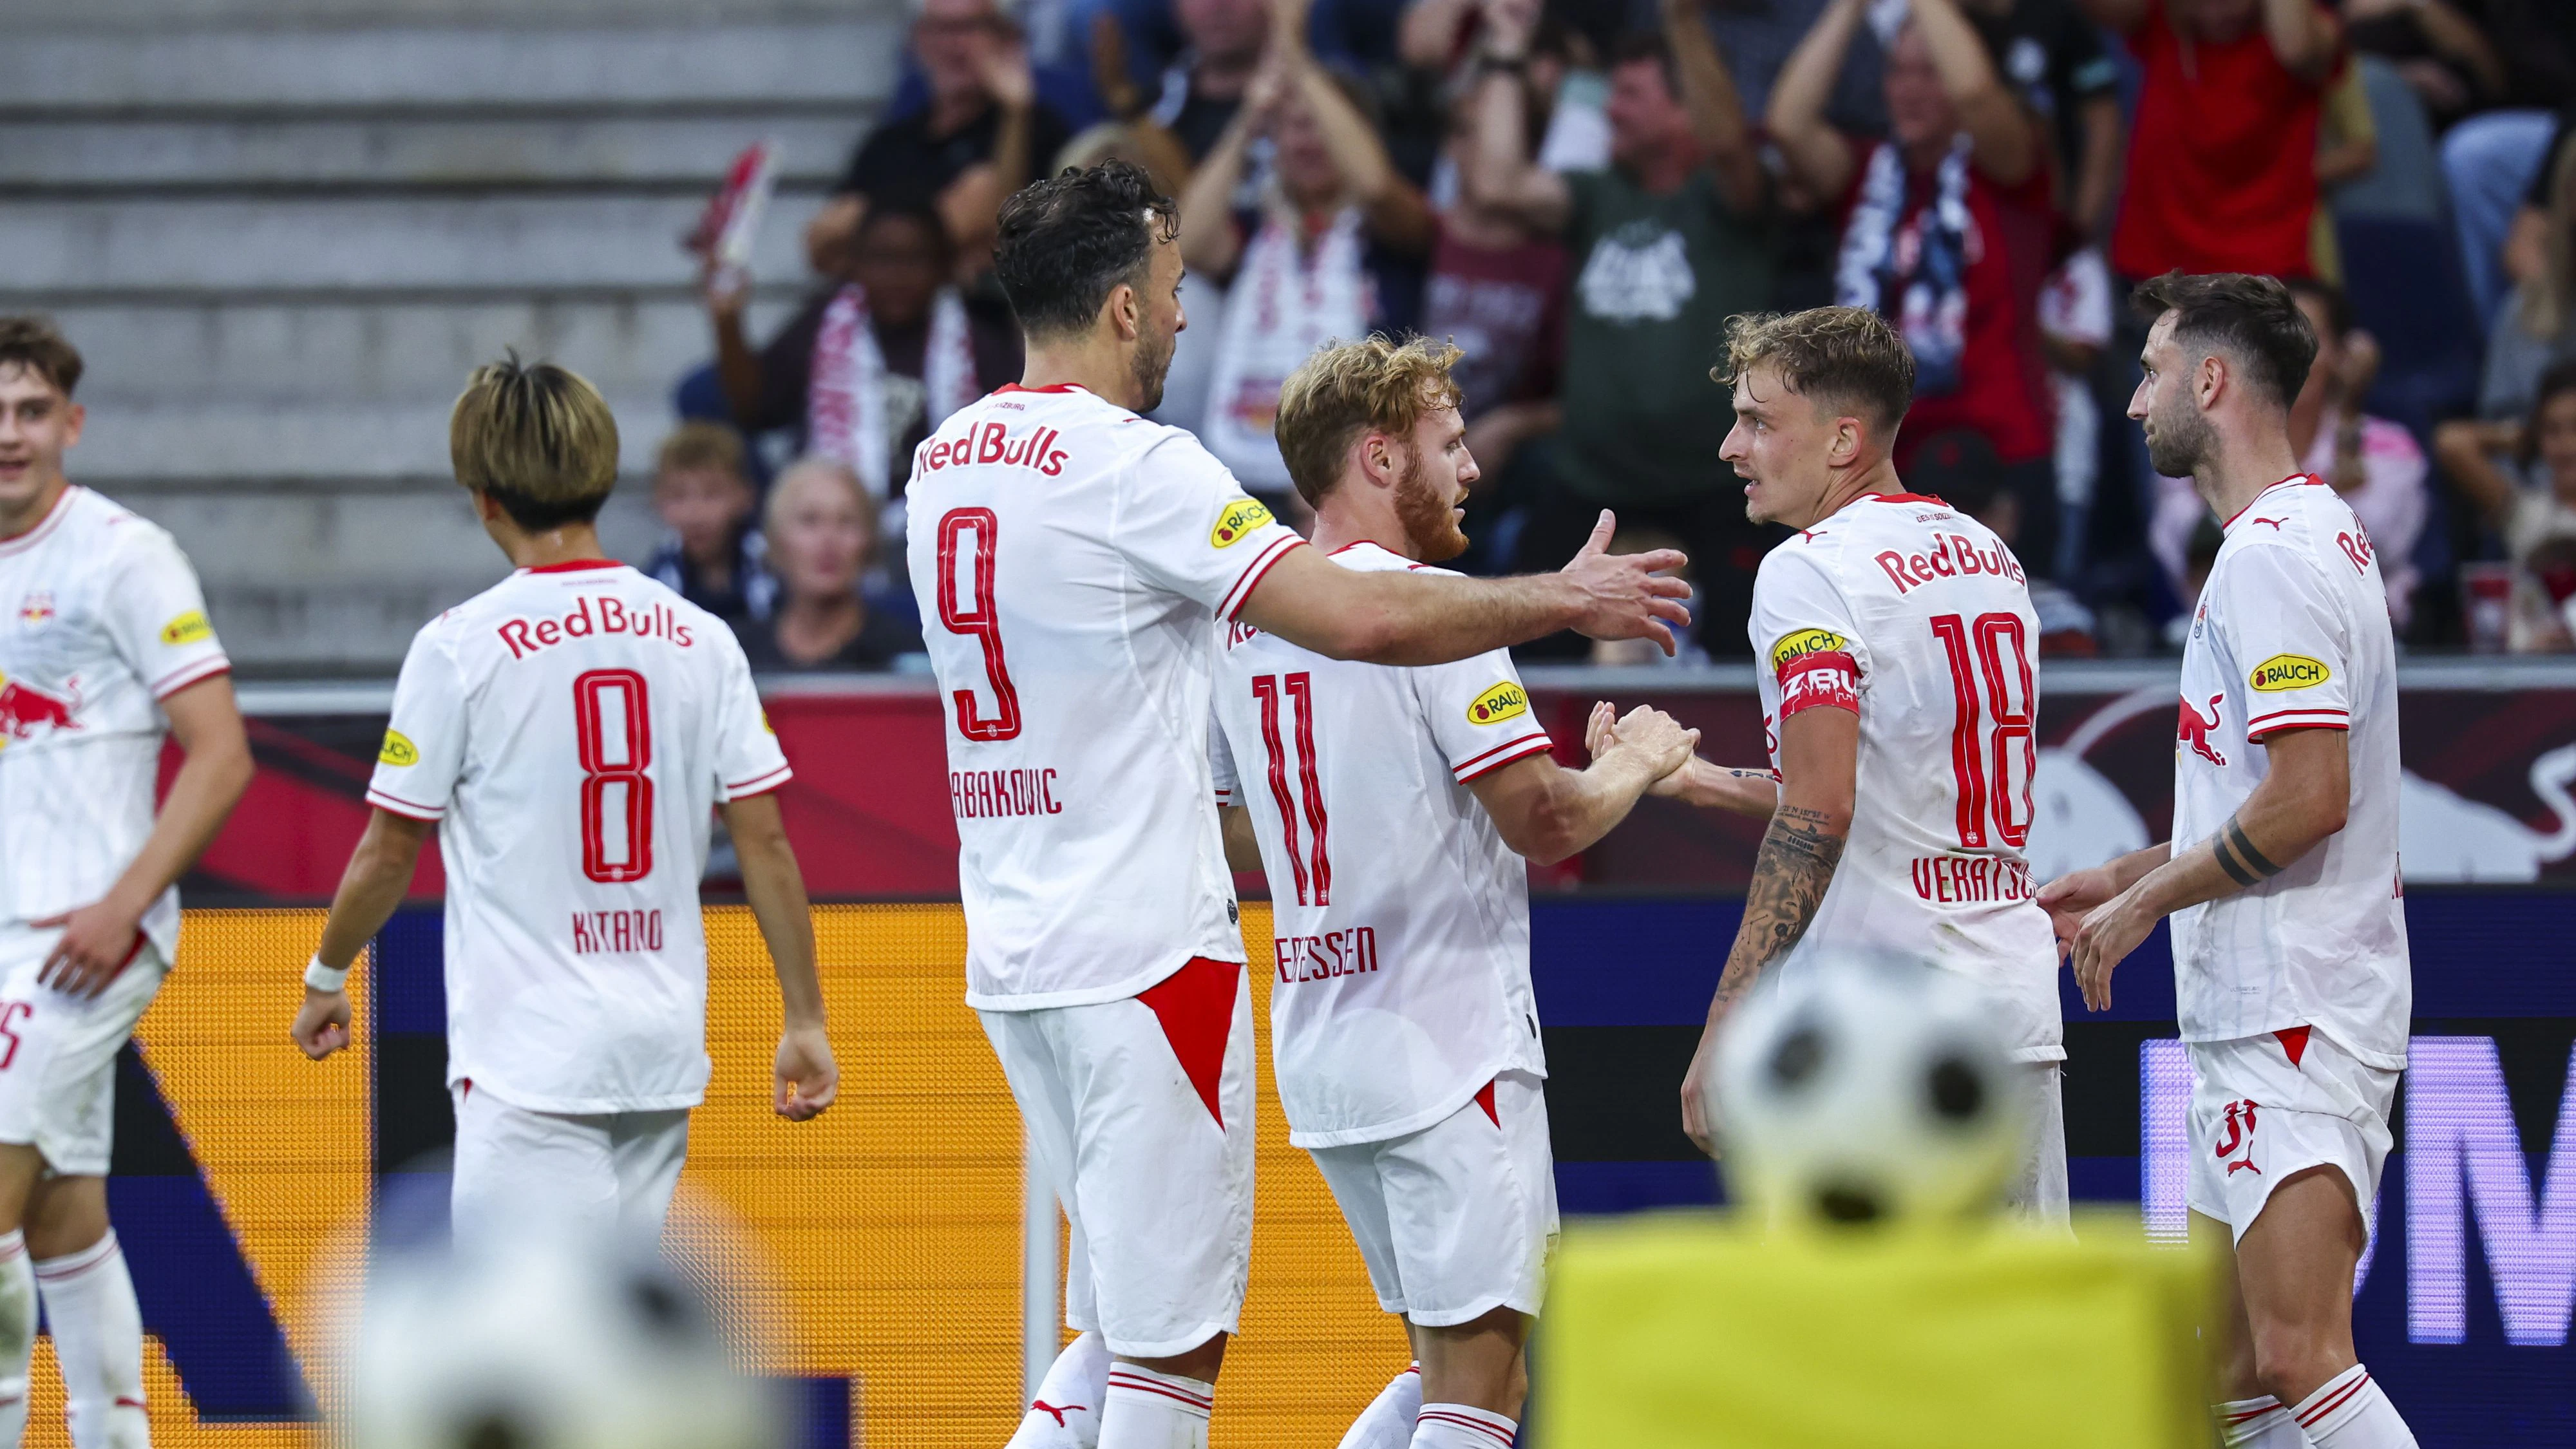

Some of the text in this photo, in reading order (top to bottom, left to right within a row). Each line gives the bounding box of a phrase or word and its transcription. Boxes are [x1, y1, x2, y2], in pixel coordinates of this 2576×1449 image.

[917, 421, 1069, 482] Red Bulls
[1874, 533, 2025, 594] Red Bulls
[2336, 511, 2372, 576] Re
[498, 597, 694, 659] Red Bulls
[937, 507, 1021, 741] 9
[1781, 633, 1836, 661] RAUCH
[2267, 664, 2320, 683] RAUCH
[1929, 612, 2036, 848] 18
[574, 668, 653, 882] 8
[951, 768, 1063, 818] ABAKOVIC
[1252, 671, 1332, 906] 11
[573, 909, 662, 954] KITANO
